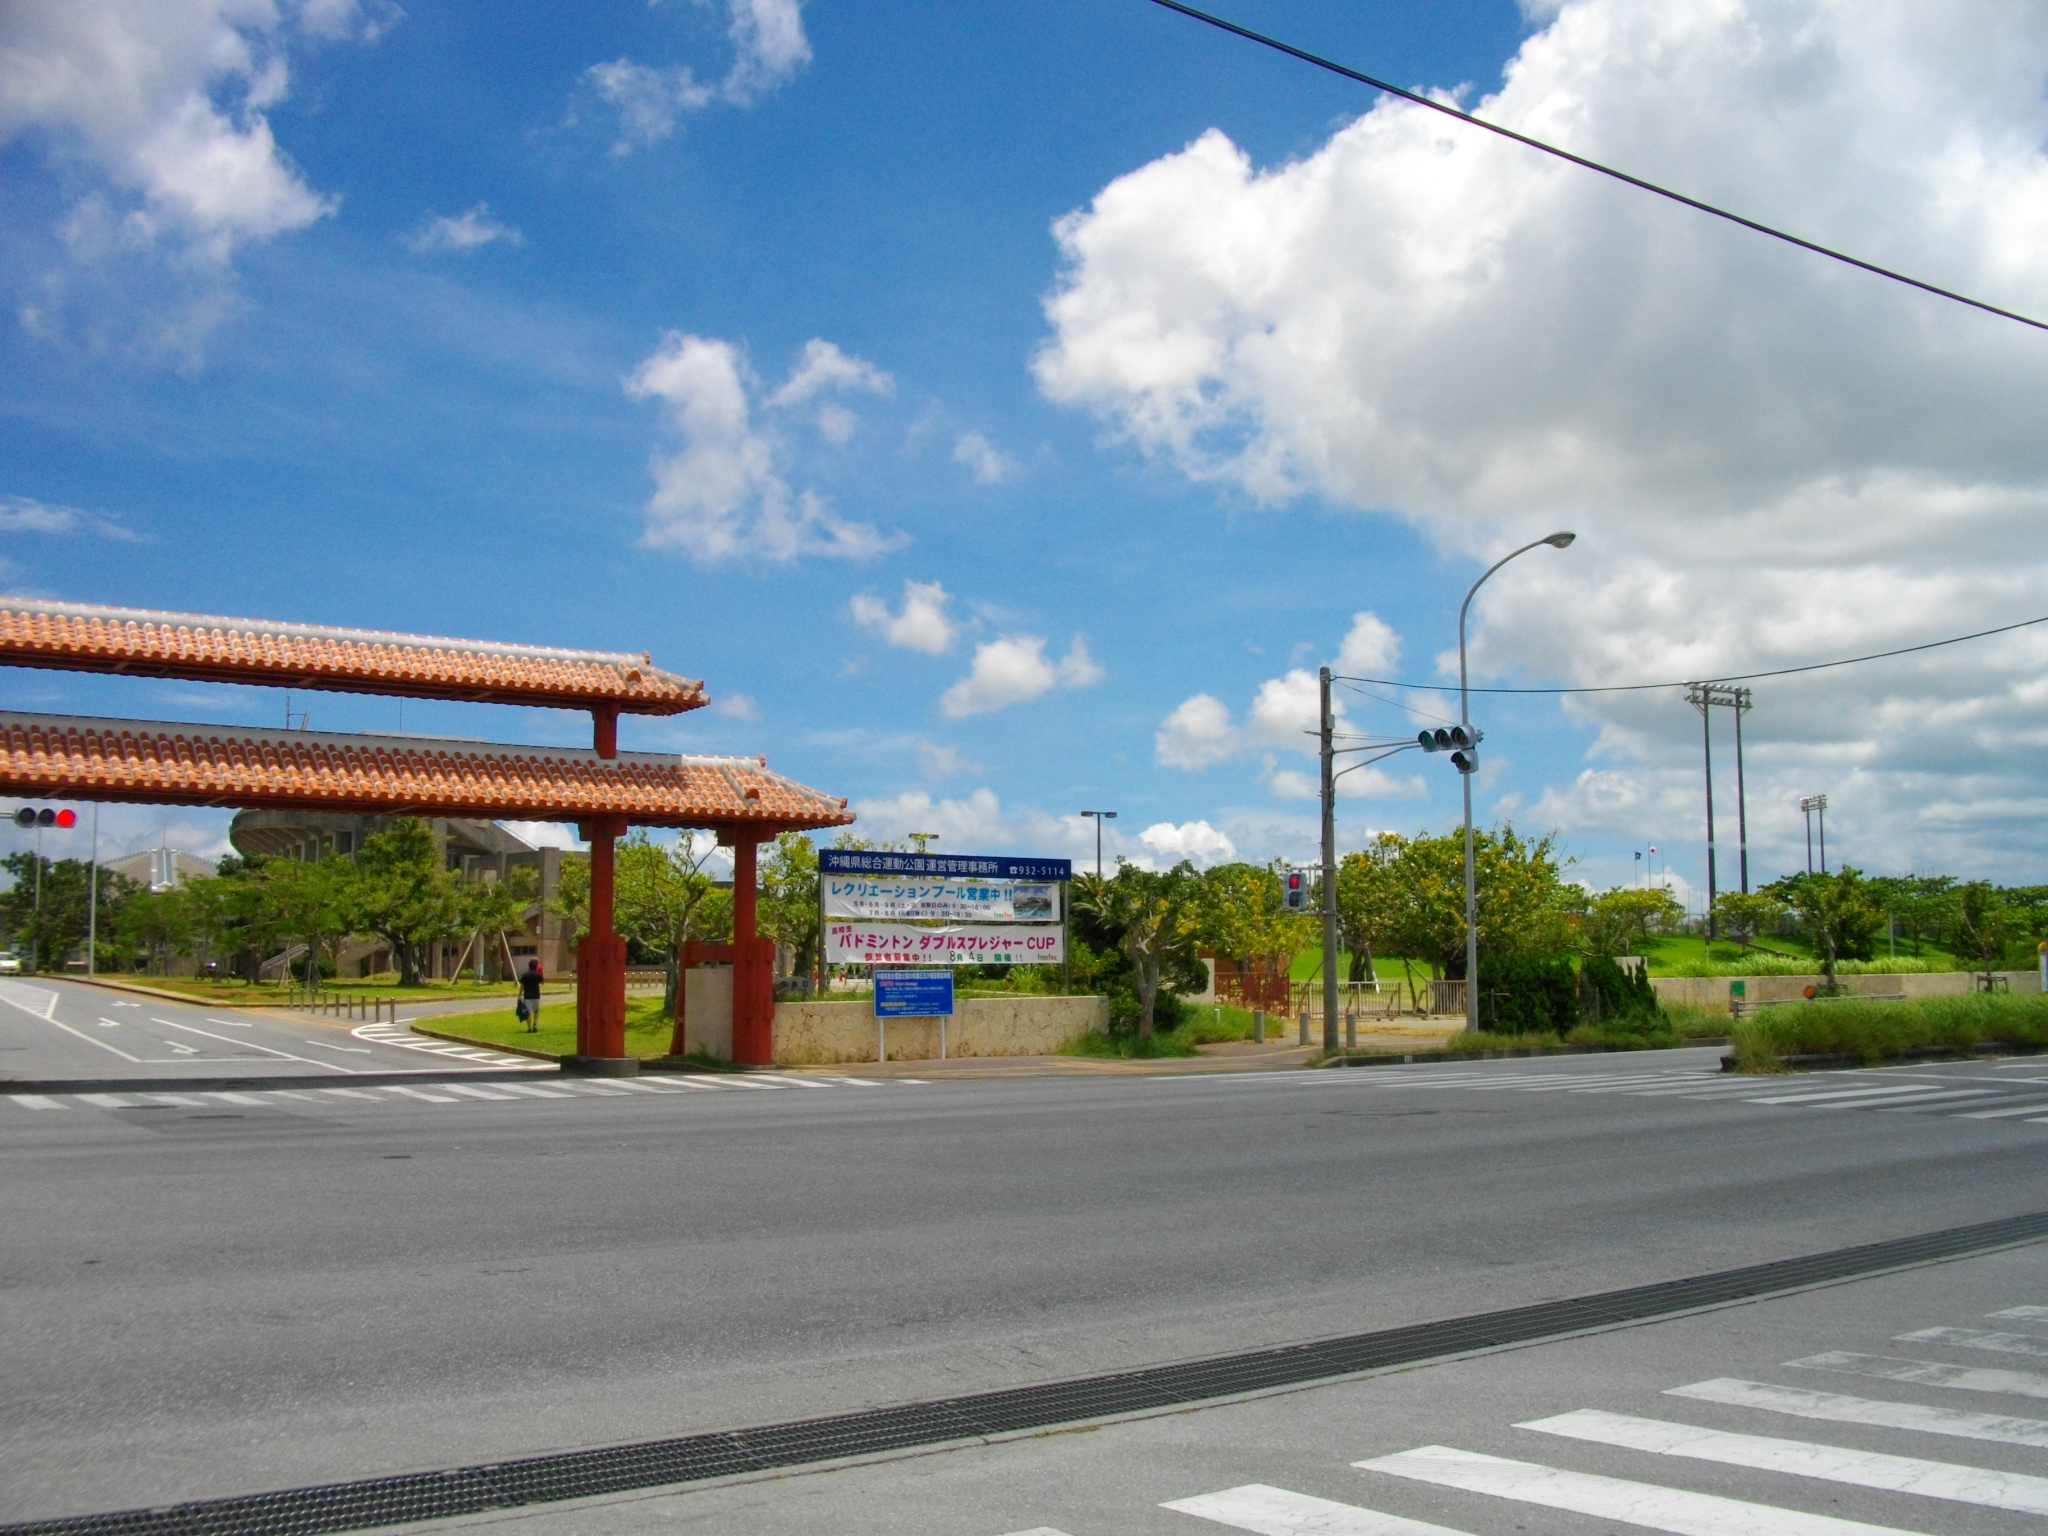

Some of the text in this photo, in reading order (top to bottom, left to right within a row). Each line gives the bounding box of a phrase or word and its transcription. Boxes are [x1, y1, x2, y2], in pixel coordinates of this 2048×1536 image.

[839, 934, 914, 950] バドミントン
[1026, 936, 1056, 950] CUP
